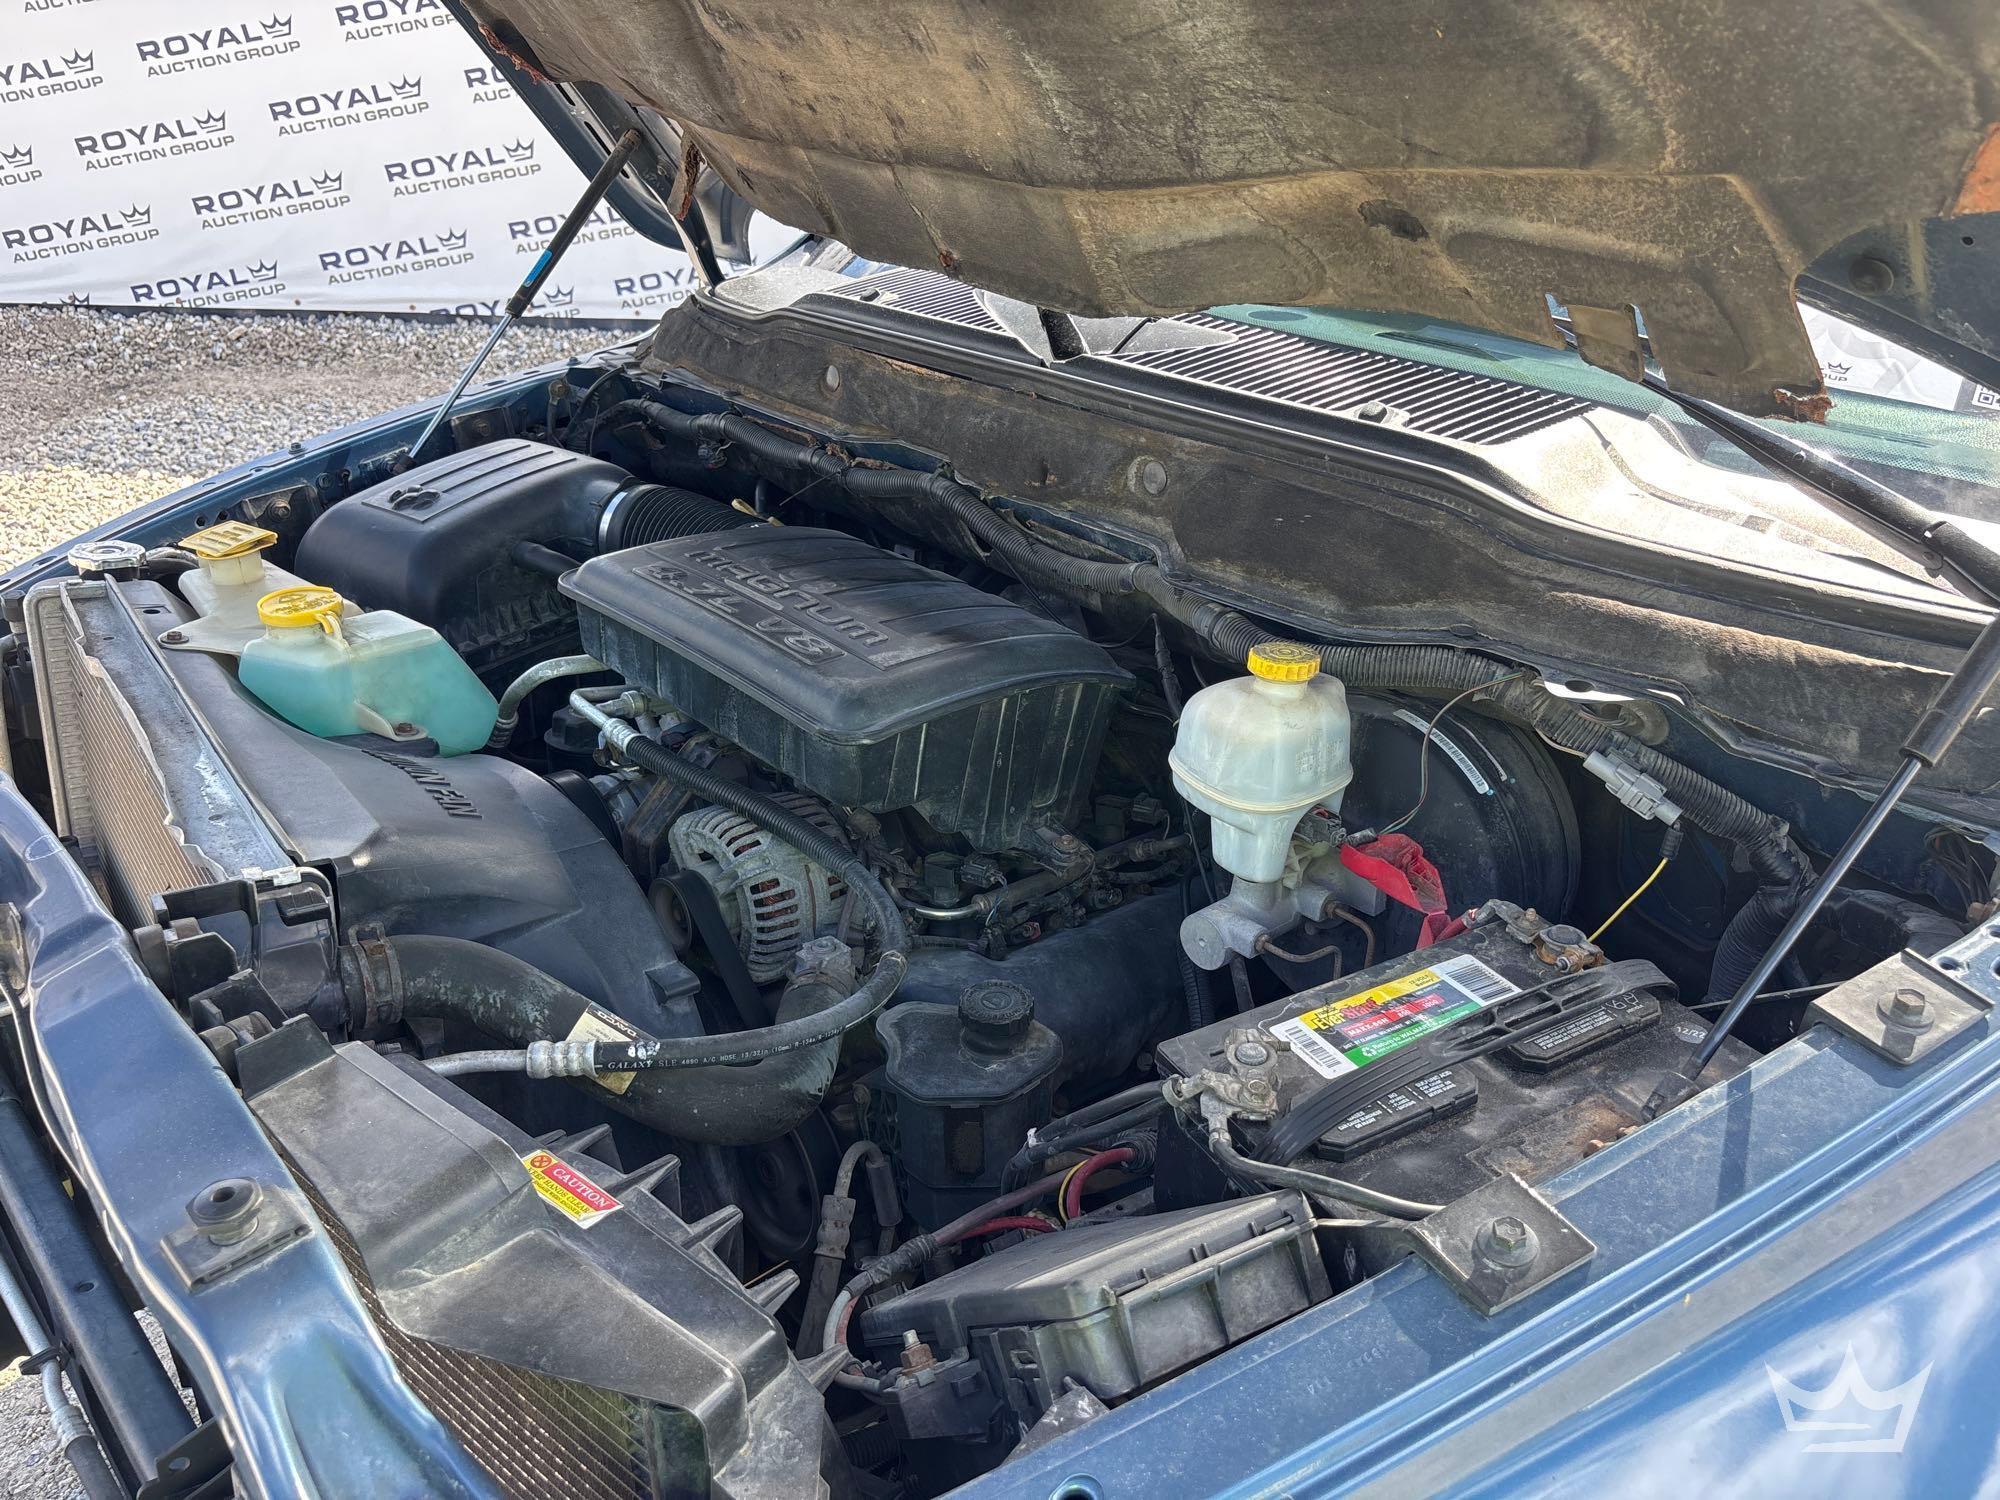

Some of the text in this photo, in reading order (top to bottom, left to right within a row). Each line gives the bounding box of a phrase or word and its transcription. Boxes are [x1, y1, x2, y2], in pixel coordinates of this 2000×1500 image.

[335, 0, 440, 26] ROYA
[345, 18, 428, 42] AUCTION
[136, 24, 263, 62] ROYAL
[147, 40, 300, 77] AUCTION GROUP
[0, 59, 65, 86] YAL
[37, 76, 103, 97] GROUP
[268, 85, 392, 121] ROYAL
[278, 101, 429, 137] AUCTION GROUP
[74, 119, 198, 156] ROYAL
[85, 135, 235, 171] AUCTION GROUP
[384, 147, 506, 182] ROYAL
[393, 163, 542, 197] AUCTION GROUP
[191, 179, 314, 216] ROYAL
[201, 195, 351, 230] AUCTION GROUP
[1, 212, 124, 249] ROYAL
[508, 206, 625, 240] ROAL
[598, 226, 635, 239] GRO
[13, 228, 160, 264] AUCTION GROUP
[318, 237, 440, 271] ROYAL
[130, 268, 250, 303] ROYAL
[328, 252, 475, 285] AUCTION GROUP
[615, 266, 701, 296] ROYA
[223, 283, 287, 302] GROUP
[596, 1010, 637, 1037] DAYCO
[608, 1060, 653, 1069] GALAXY
[720, 1053, 737, 1061] HOSE
[545, 1178, 567, 1198] HANDS
[566, 1193, 590, 1213] CLEAR
[553, 1168, 610, 1207] CAUTION
